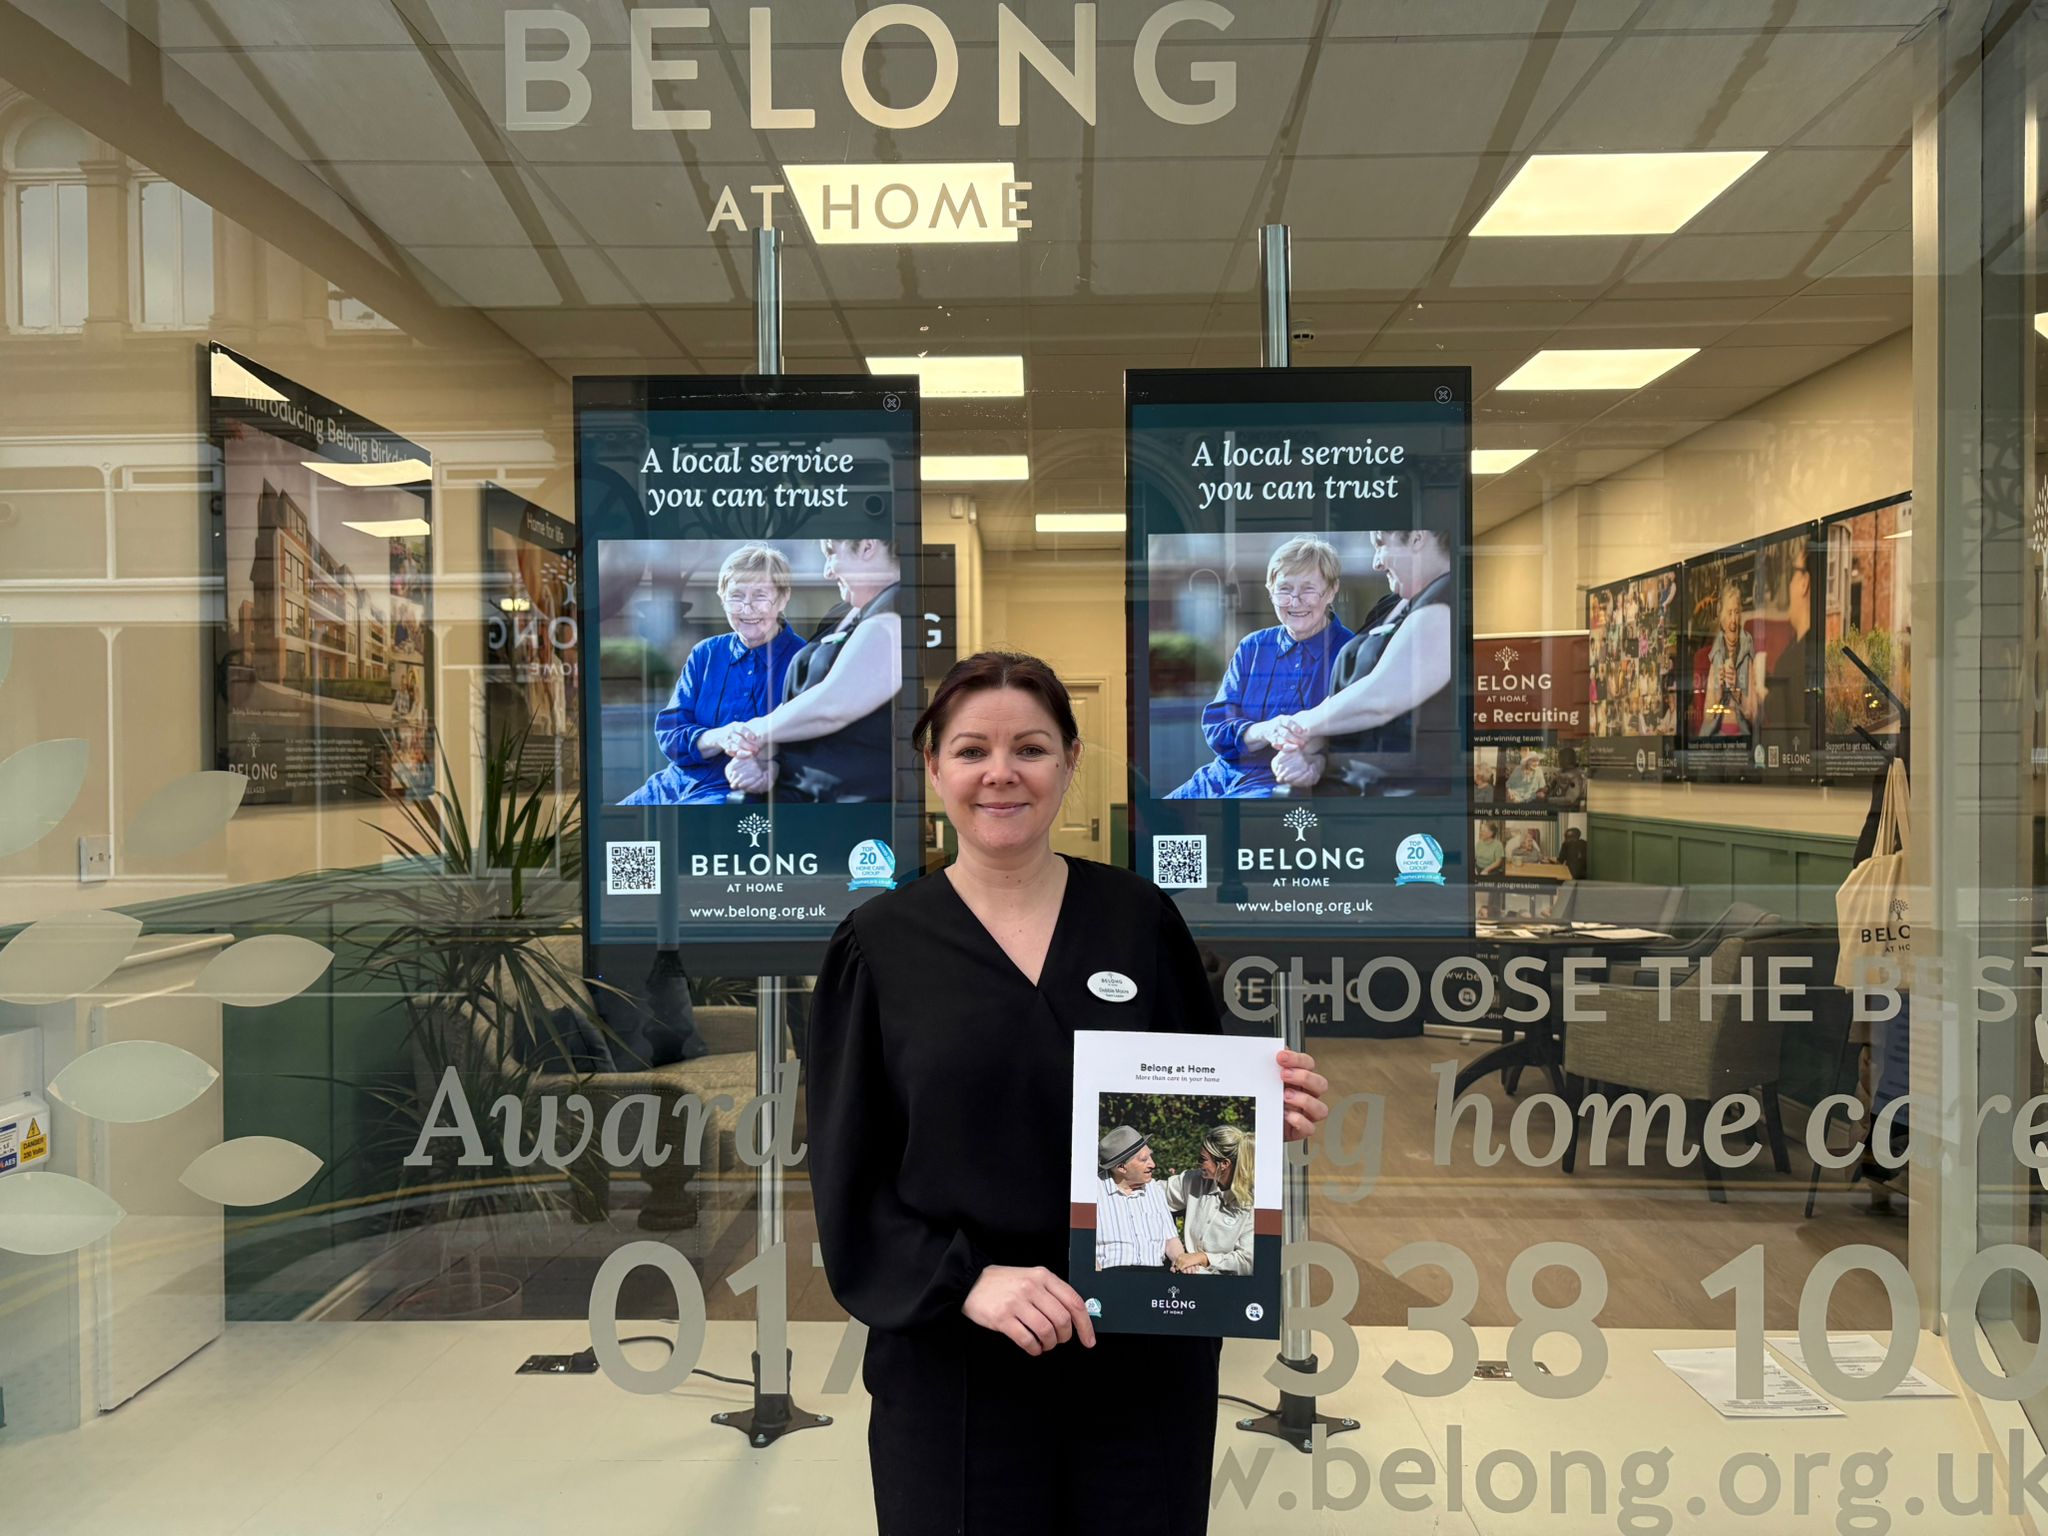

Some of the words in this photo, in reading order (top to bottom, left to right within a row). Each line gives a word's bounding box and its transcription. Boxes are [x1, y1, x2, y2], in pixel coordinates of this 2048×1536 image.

[503, 1, 1238, 131] BELONG
[706, 184, 785, 233] AT
[822, 181, 1033, 231] HOME
[327, 417, 368, 463] Belong
[370, 439, 408, 464] Birkd
[640, 448, 663, 474] A
[671, 447, 742, 474] local
[750, 446, 854, 473] service
[1191, 441, 1214, 467] A
[1223, 439, 1292, 467] local
[1300, 438, 1404, 466] service
[648, 487, 704, 516] you
[711, 487, 766, 508] can
[774, 483, 849, 508] trust
[1198, 480, 1254, 509] you
[1262, 479, 1316, 501] can
[1324, 475, 1399, 499] trust
[1477, 673, 1552, 691] ELONG
[1486, 695, 1497, 703] AT
[1500, 695, 1527, 703] HOME
[1473, 711, 1487, 723] re
[1493, 707, 1580, 726] Recruiting
[1474, 735, 1521, 743] ward-winning
[1825, 742, 1845, 754] Support
[1782, 753, 1811, 764] BELONG
[1475, 808, 1493, 816] ining
[1501, 808, 1548, 817] development
[860, 852, 877, 865] 20
[1237, 847, 1365, 870] BELONG
[1407, 847, 1425, 860] 20
[691, 853, 819, 877] BELONG
[727, 883, 744, 893] AT
[747, 883, 784, 893] HOME
[1272, 877, 1288, 887] AT
[1292, 877, 1331, 887] HOME
[690, 903, 827, 920] www.belong.org.uk
[1236, 899, 1374, 915] www.belong.org.uk
[1223, 955, 1607, 1023] CHOOSE
[1641, 956, 1813, 1022] THE
[1140, 1063, 1173, 1074] Belong
[1175, 1065, 1185, 1073] at
[1187, 1065, 1216, 1074] Home
[1189, 1076, 1204, 1084] your
[403, 1059, 807, 1168] Award
[1430, 1059, 1763, 1169] home
[23, 1137, 44, 1150] DANGER
[1151, 1299, 1196, 1310] BELONG
[1700, 1243, 2048, 1401] 100
[1211, 1422, 2048, 1536] w.belong.org.uk
